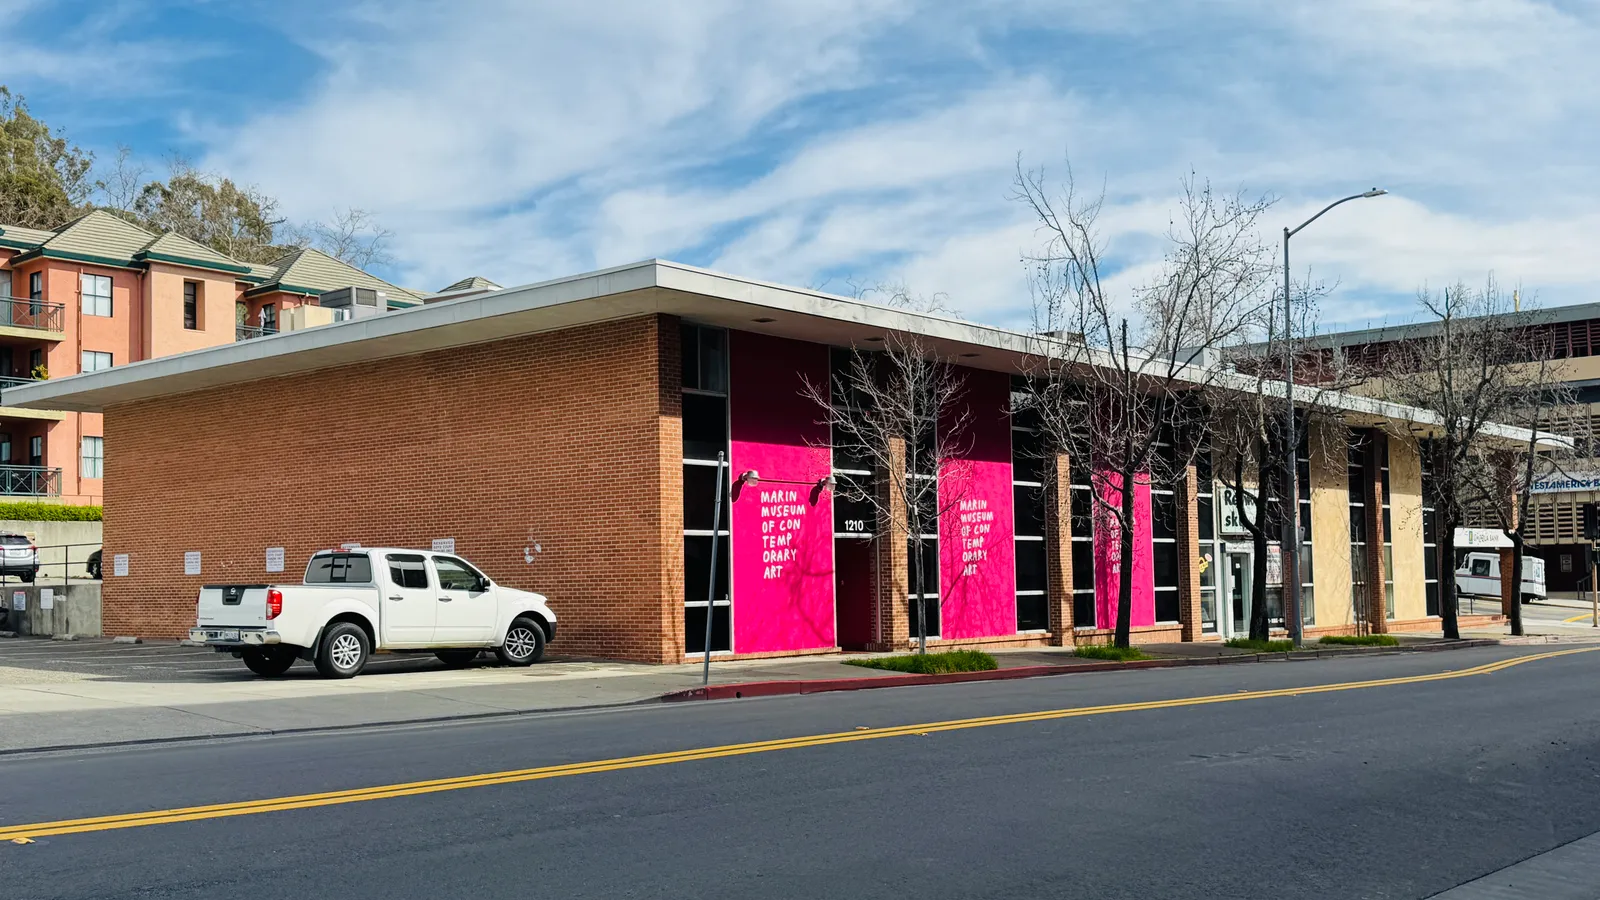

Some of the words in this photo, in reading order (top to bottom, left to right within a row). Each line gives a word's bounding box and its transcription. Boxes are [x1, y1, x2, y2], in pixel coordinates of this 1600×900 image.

[760, 490, 797, 503] MARIN
[761, 504, 806, 518] MUSEUM
[960, 499, 987, 511] MARIN
[960, 511, 994, 523] MUSEUM
[761, 521, 775, 534] OF
[779, 518, 801, 532] CON
[844, 519, 864, 532] 1210
[961, 525, 972, 537] OF
[973, 523, 991, 535] CON
[762, 532, 793, 549] TEMP
[962, 536, 984, 550] TEMP
[762, 548, 797, 563] ORARY
[962, 550, 988, 562] ORARY
[763, 564, 784, 579] ART
[963, 563, 978, 577] ART
